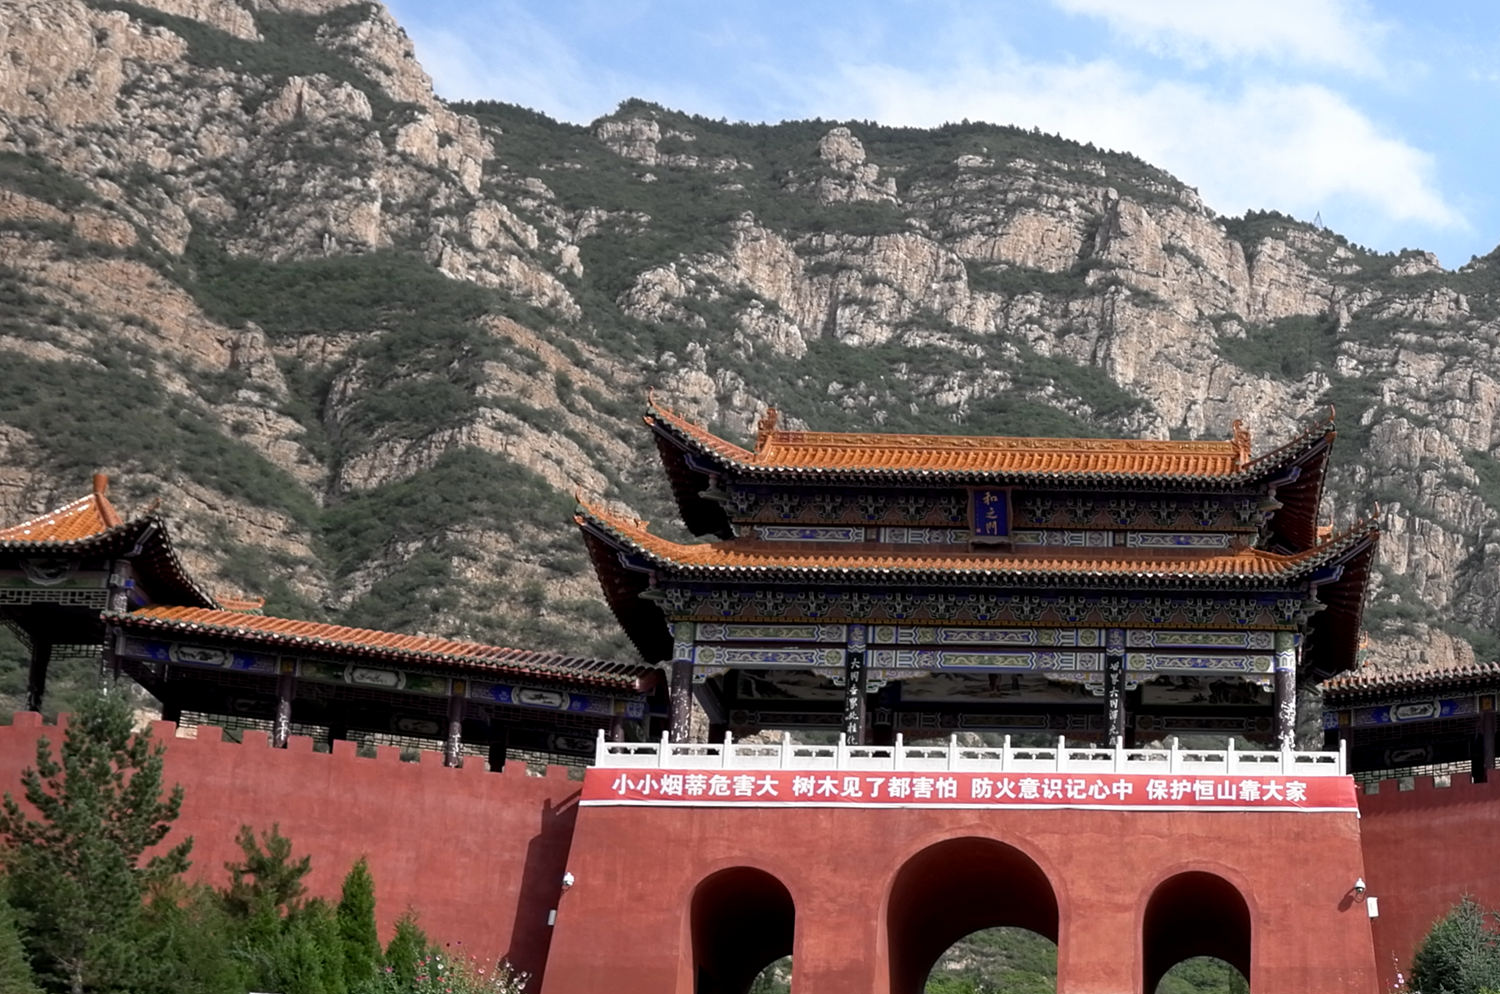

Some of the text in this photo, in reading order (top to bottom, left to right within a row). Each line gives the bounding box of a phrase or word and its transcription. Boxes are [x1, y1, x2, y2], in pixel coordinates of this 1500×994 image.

[611, 773, 1308, 802] 小小烟蒂危害大 树木见了都害怕 防火意识记心中 保护恒山靠大家
